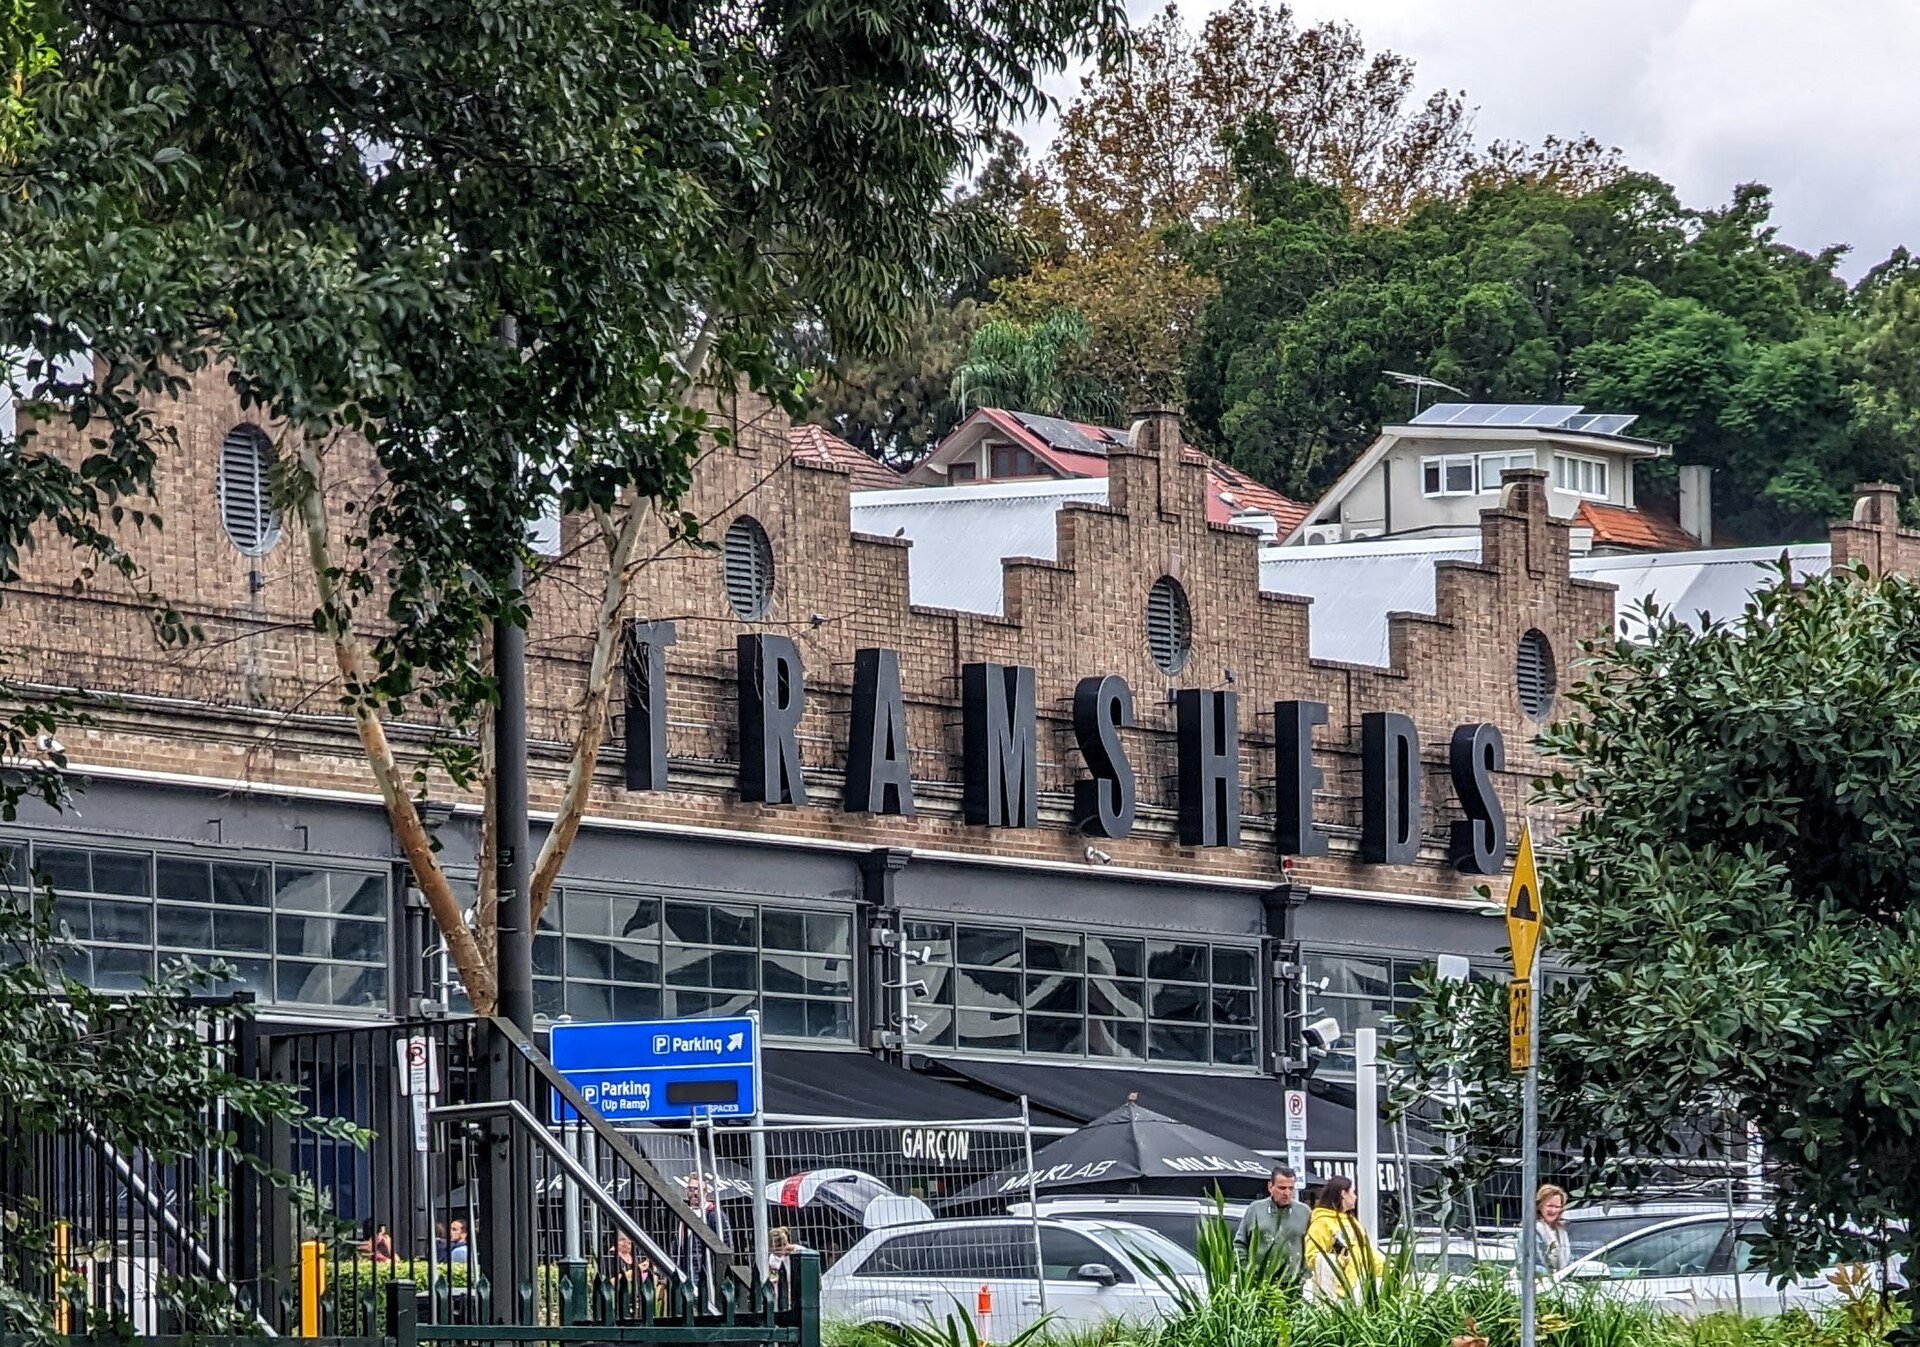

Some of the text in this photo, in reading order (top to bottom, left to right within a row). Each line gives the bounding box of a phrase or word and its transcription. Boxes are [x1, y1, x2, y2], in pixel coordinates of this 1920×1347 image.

[624, 617, 1507, 876] TRAMSHEDS
[1514, 988, 1527, 1036] 25
[673, 1036, 722, 1055] Parking
[601, 1080, 651, 1099] Parking
[601, 1099, 650, 1112] (Up Ramp)
[902, 1128, 970, 1167] GARÇON
[1313, 1161, 1405, 1192] TRAMEDS
